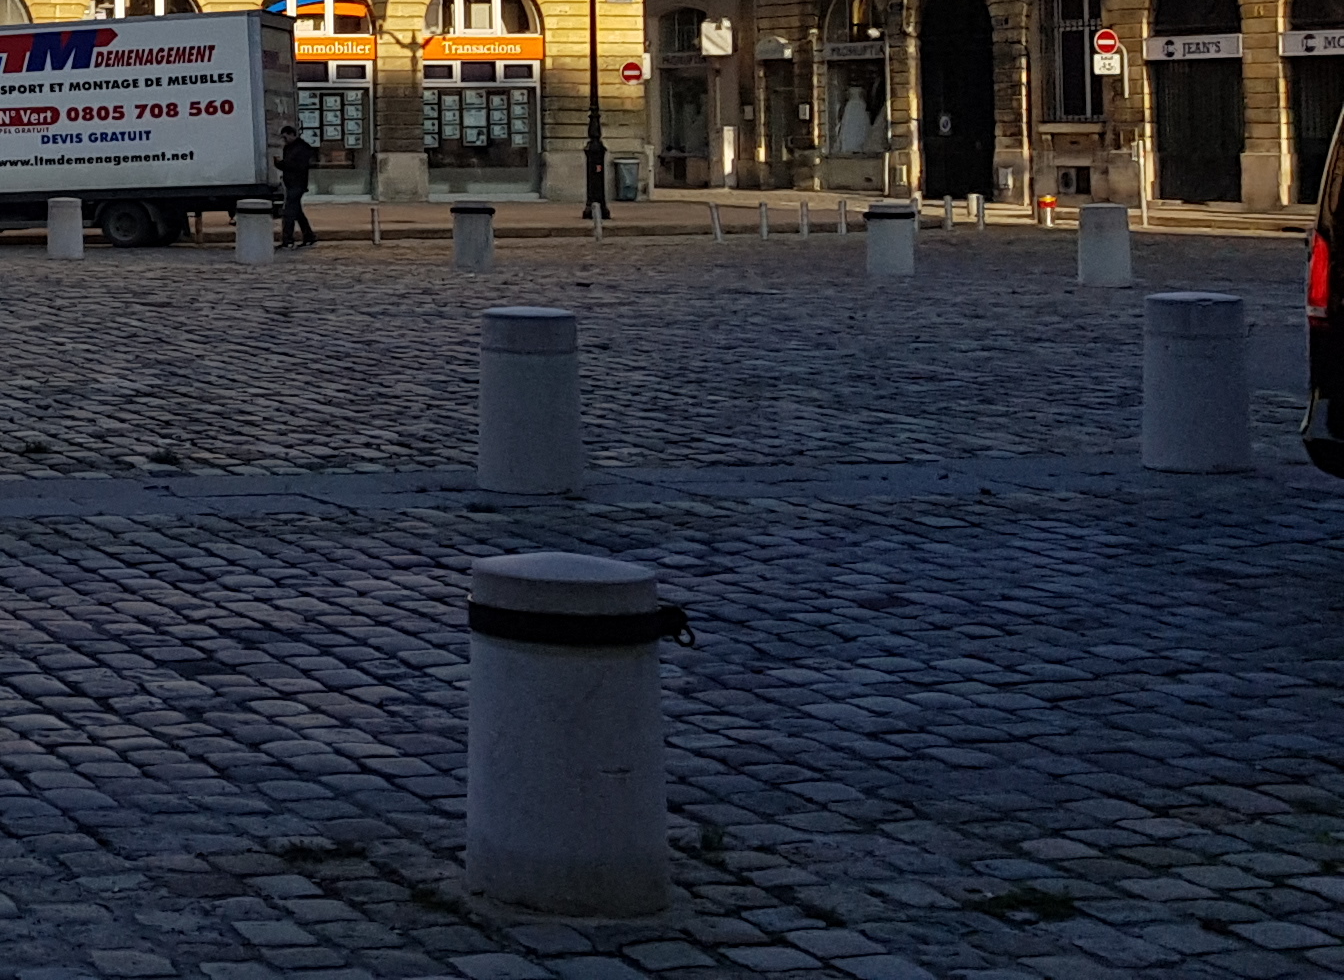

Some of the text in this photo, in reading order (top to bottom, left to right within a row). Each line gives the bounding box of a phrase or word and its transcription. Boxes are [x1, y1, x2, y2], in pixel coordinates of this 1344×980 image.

[295, 41, 371, 54] Immobilier
[442, 41, 522, 54] Transactions
[94, 45, 216, 68] DEMENAGEMENT
[49, 82, 64, 93] ET
[69, 78, 140, 92] MONTAGE
[145, 76, 163, 88] DE
[167, 73, 234, 86] MEUBLES
[20, 109, 53, 124] Vert
[66, 105, 125, 122] 0805
[134, 102, 179, 119] 708
[188, 99, 235, 117] 560
[14, 126, 50, 134] GRATUIT
[41, 130, 152, 145] DEVIS GRATUIT
